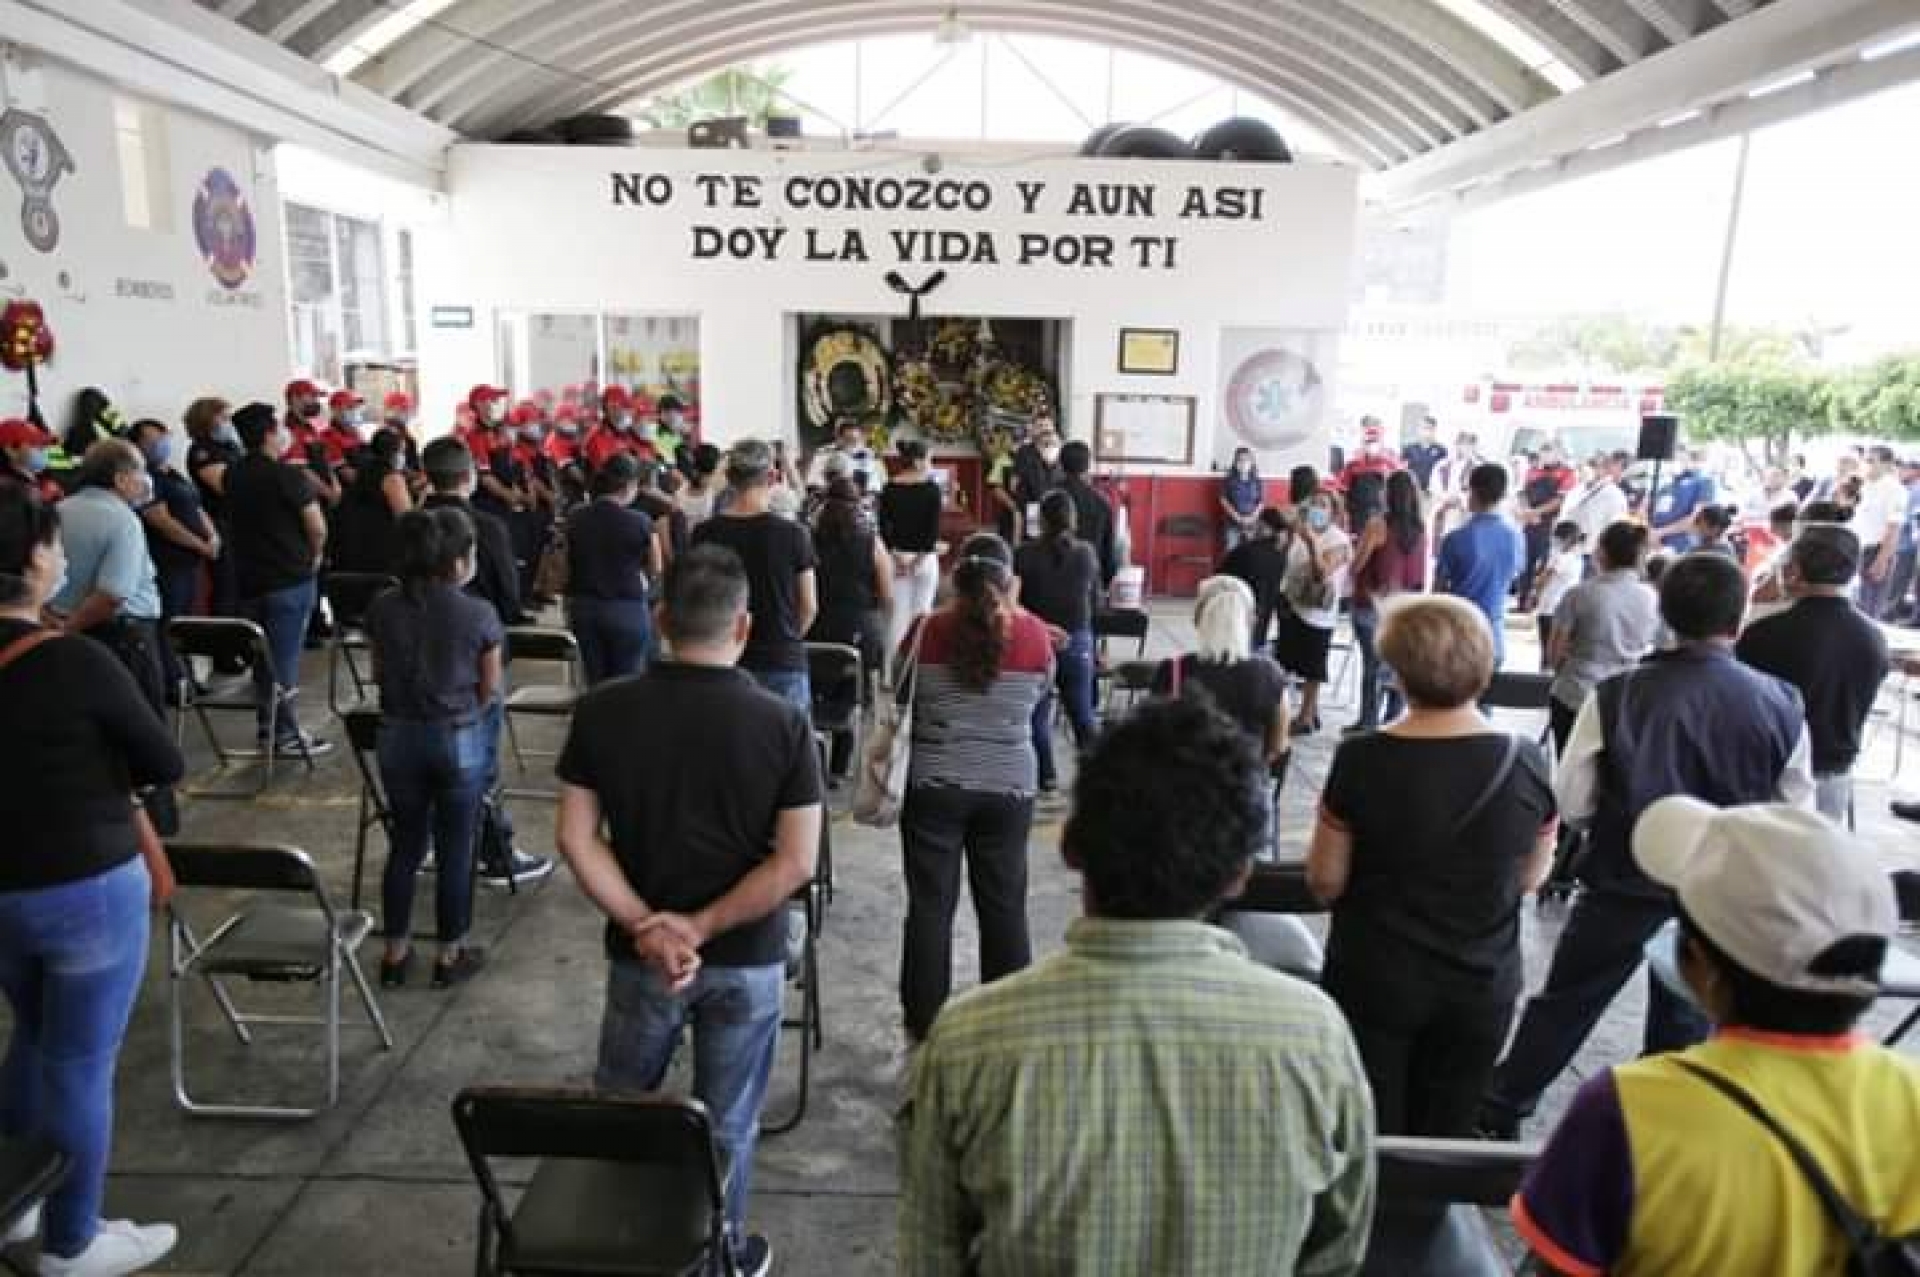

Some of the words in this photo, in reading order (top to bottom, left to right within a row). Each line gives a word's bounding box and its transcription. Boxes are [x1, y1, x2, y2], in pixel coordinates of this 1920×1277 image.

[612, 172, 673, 204] NO
[695, 175, 761, 209] TE
[785, 175, 993, 212] CONOZCO
[1015, 181, 1046, 214] Y
[1066, 183, 1155, 217] AUN
[1178, 186, 1265, 220] ASI
[692, 226, 786, 260] DOY
[805, 228, 870, 262] LA
[890, 230, 999, 265] VIDA
[1018, 233, 1113, 267] POR
[1130, 236, 1177, 268] TI
